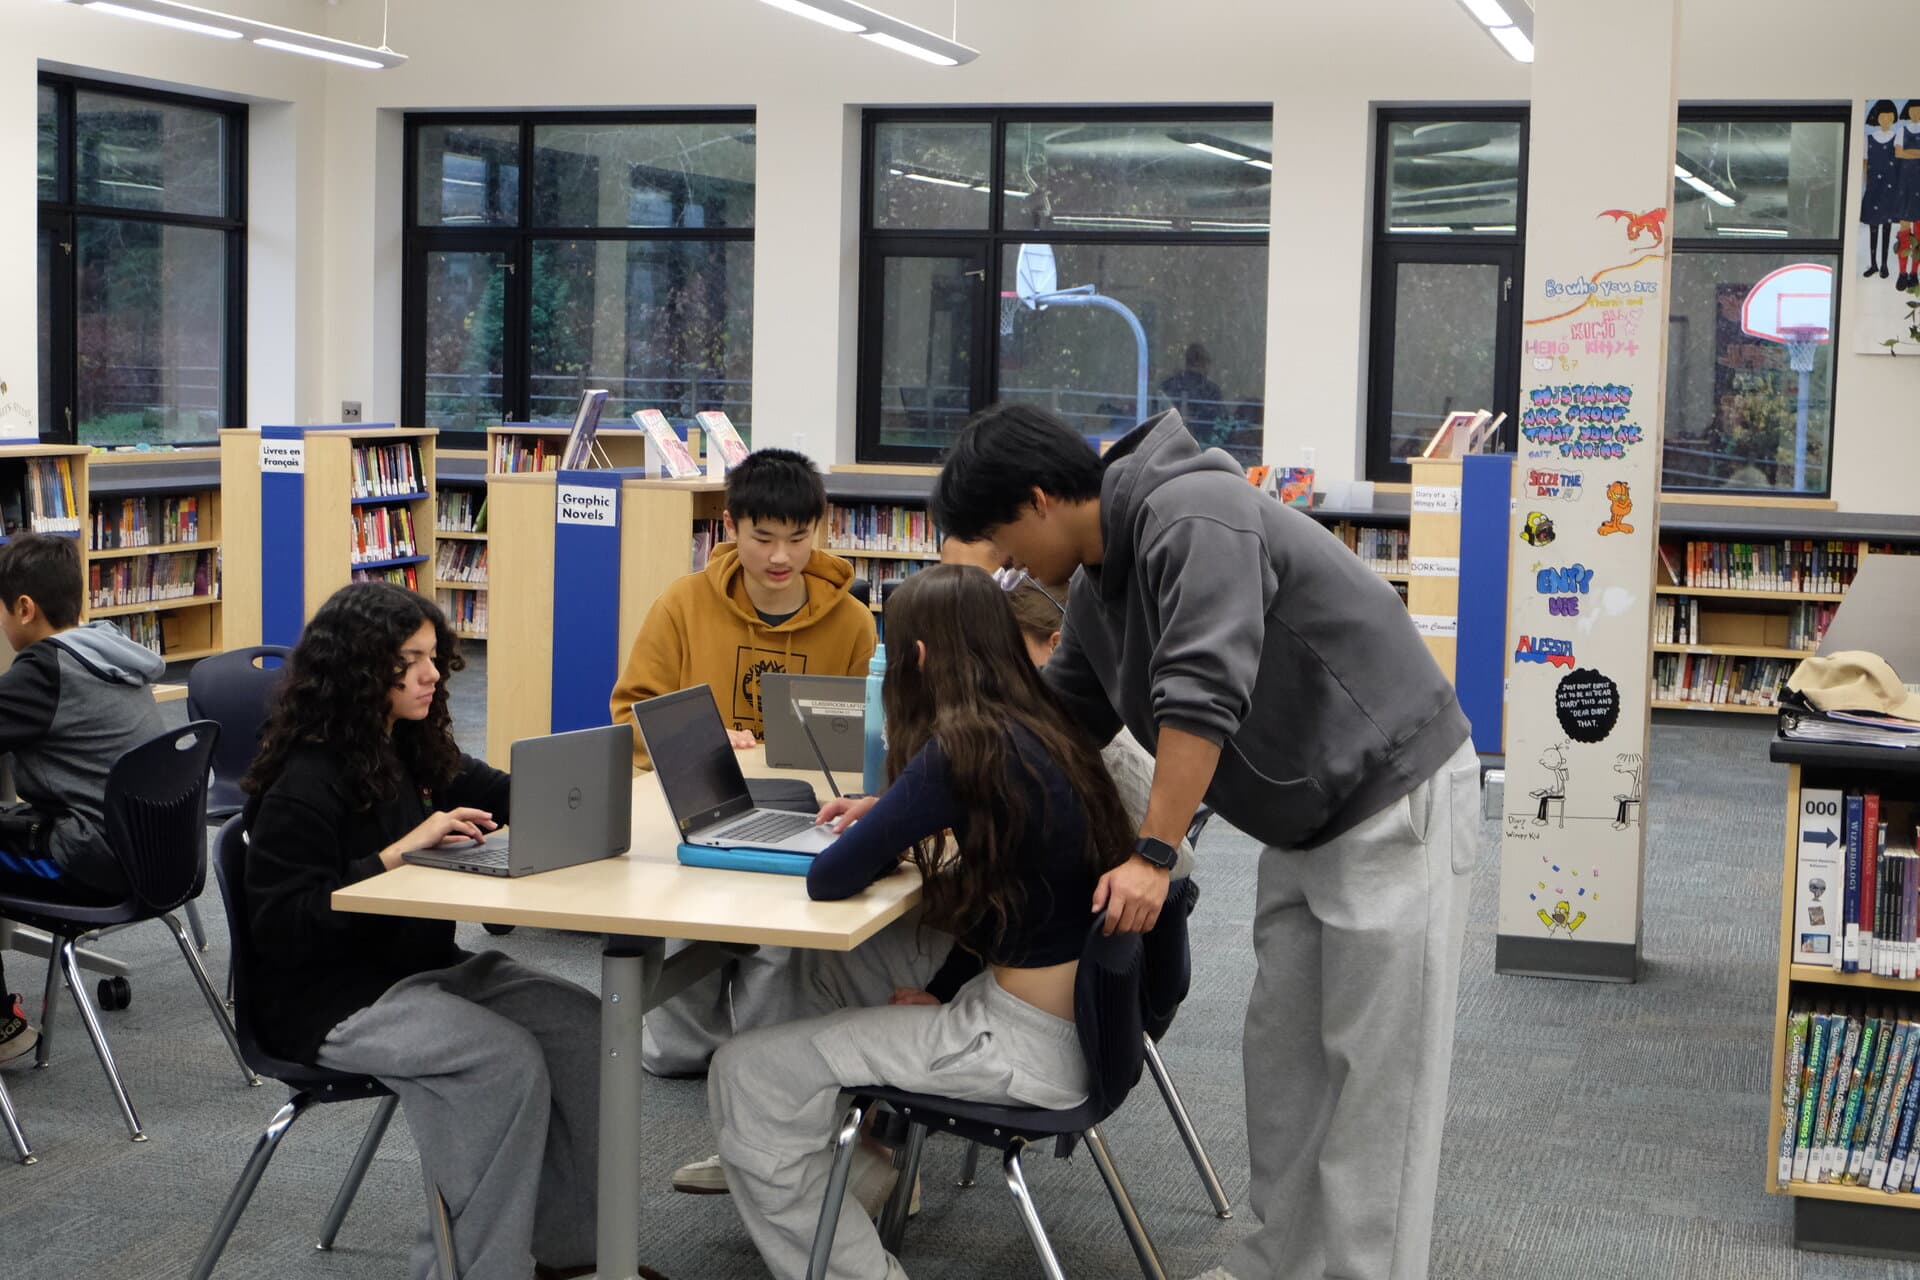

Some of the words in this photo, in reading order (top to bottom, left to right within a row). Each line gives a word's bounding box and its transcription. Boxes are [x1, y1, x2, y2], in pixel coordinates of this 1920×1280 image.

[1545, 279, 1563, 297] Be
[1565, 276, 1598, 295] who
[1600, 280, 1631, 296] you
[1634, 280, 1657, 293] are
[1521, 408, 1562, 427] ARE
[1566, 404, 1630, 424] PROOF
[1522, 423, 1574, 445] THAT
[1578, 423, 1614, 443] YOU
[263, 446, 288, 455] Livres
[264, 458, 299, 468] Français
[1529, 470, 1559, 486] SEIZE
[1560, 474, 1582, 487] THE
[563, 493, 609, 508] Graphic
[1537, 486, 1560, 497] DAY
[563, 508, 604, 520] Novels
[1410, 562, 1434, 571] DORK
[1598, 697, 1612, 705] AND
[1805, 800, 1837, 816] 000
[1848, 820, 1859, 891] WIZARDOLOGY
[1790, 1034, 1800, 1074] GUINNESS
[1857, 1027, 1872, 1069] GUINNESS
[1787, 1075, 1797, 1105] WORLD
[1783, 1107, 1794, 1144] RECORDS
[1800, 1099, 1811, 1137] RECORDS
